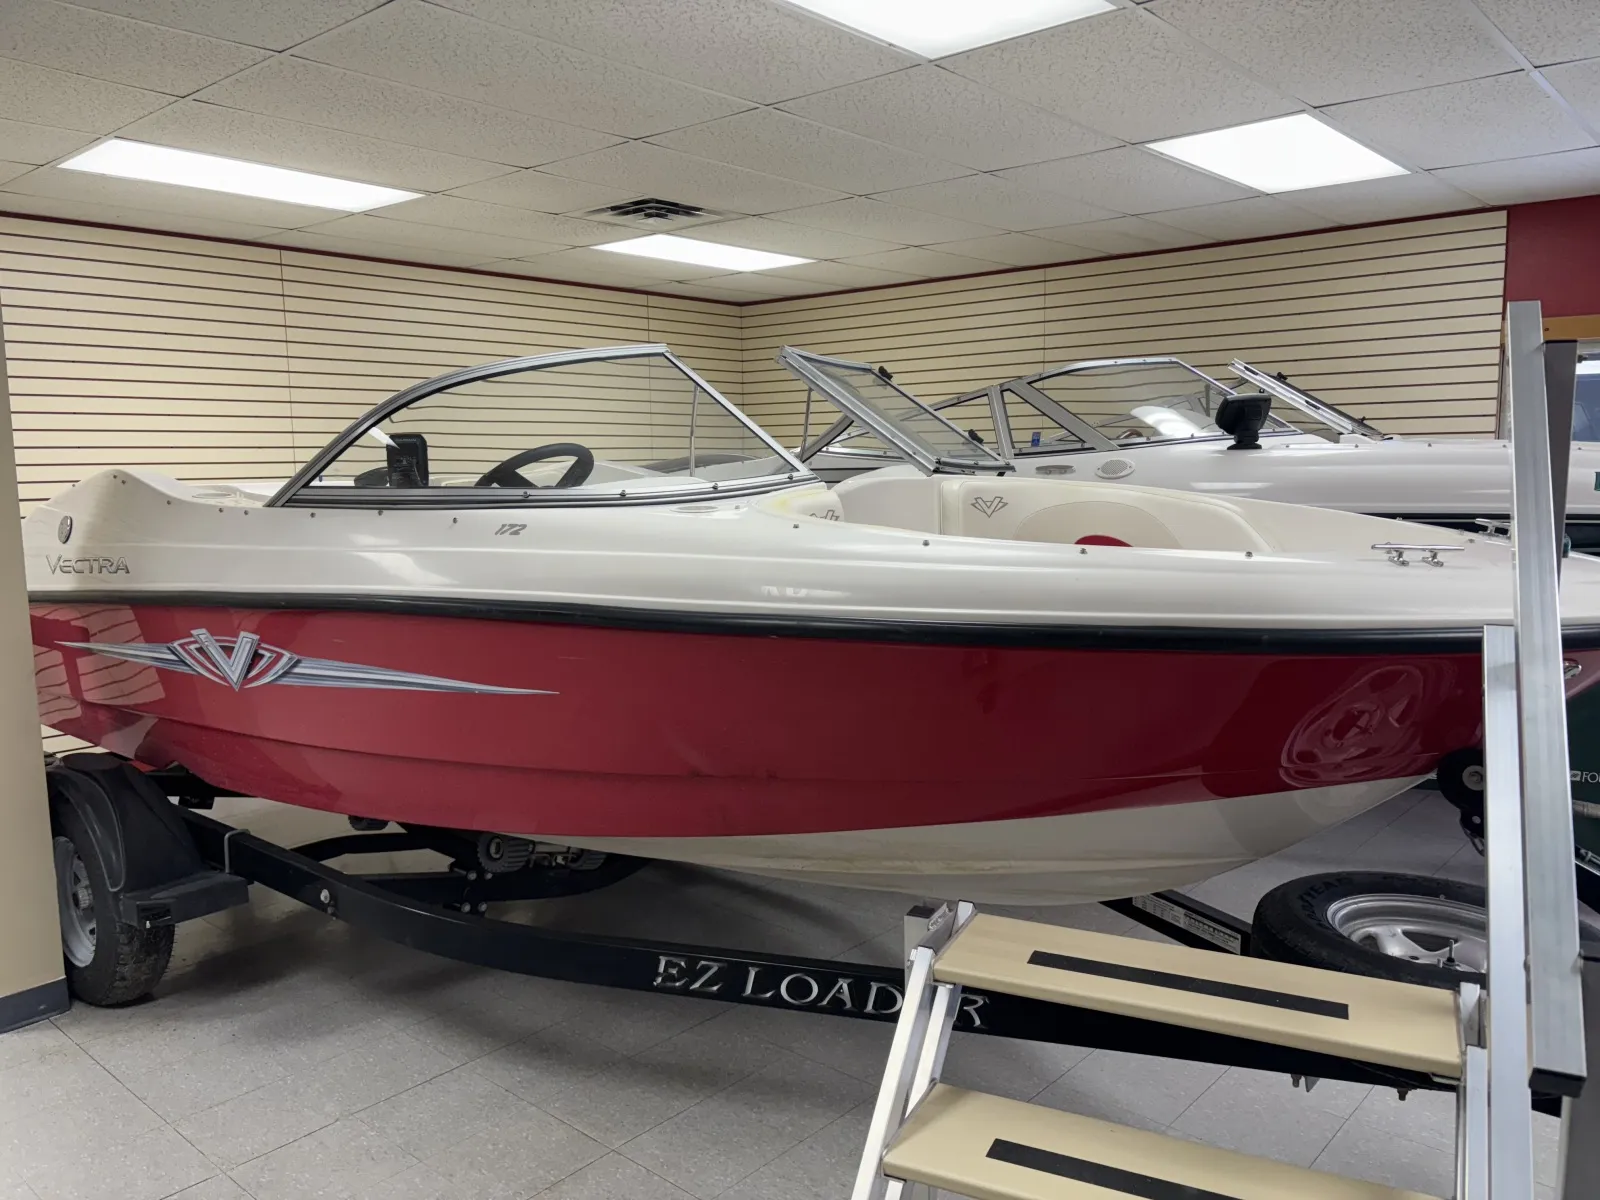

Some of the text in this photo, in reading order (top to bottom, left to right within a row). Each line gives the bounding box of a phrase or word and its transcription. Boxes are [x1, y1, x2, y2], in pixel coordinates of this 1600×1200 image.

[494, 523, 528, 536] 172
[45, 553, 131, 575] VECTRA
[1581, 771, 1600, 783] FO
[652, 954, 990, 1029] EZ LOADR
